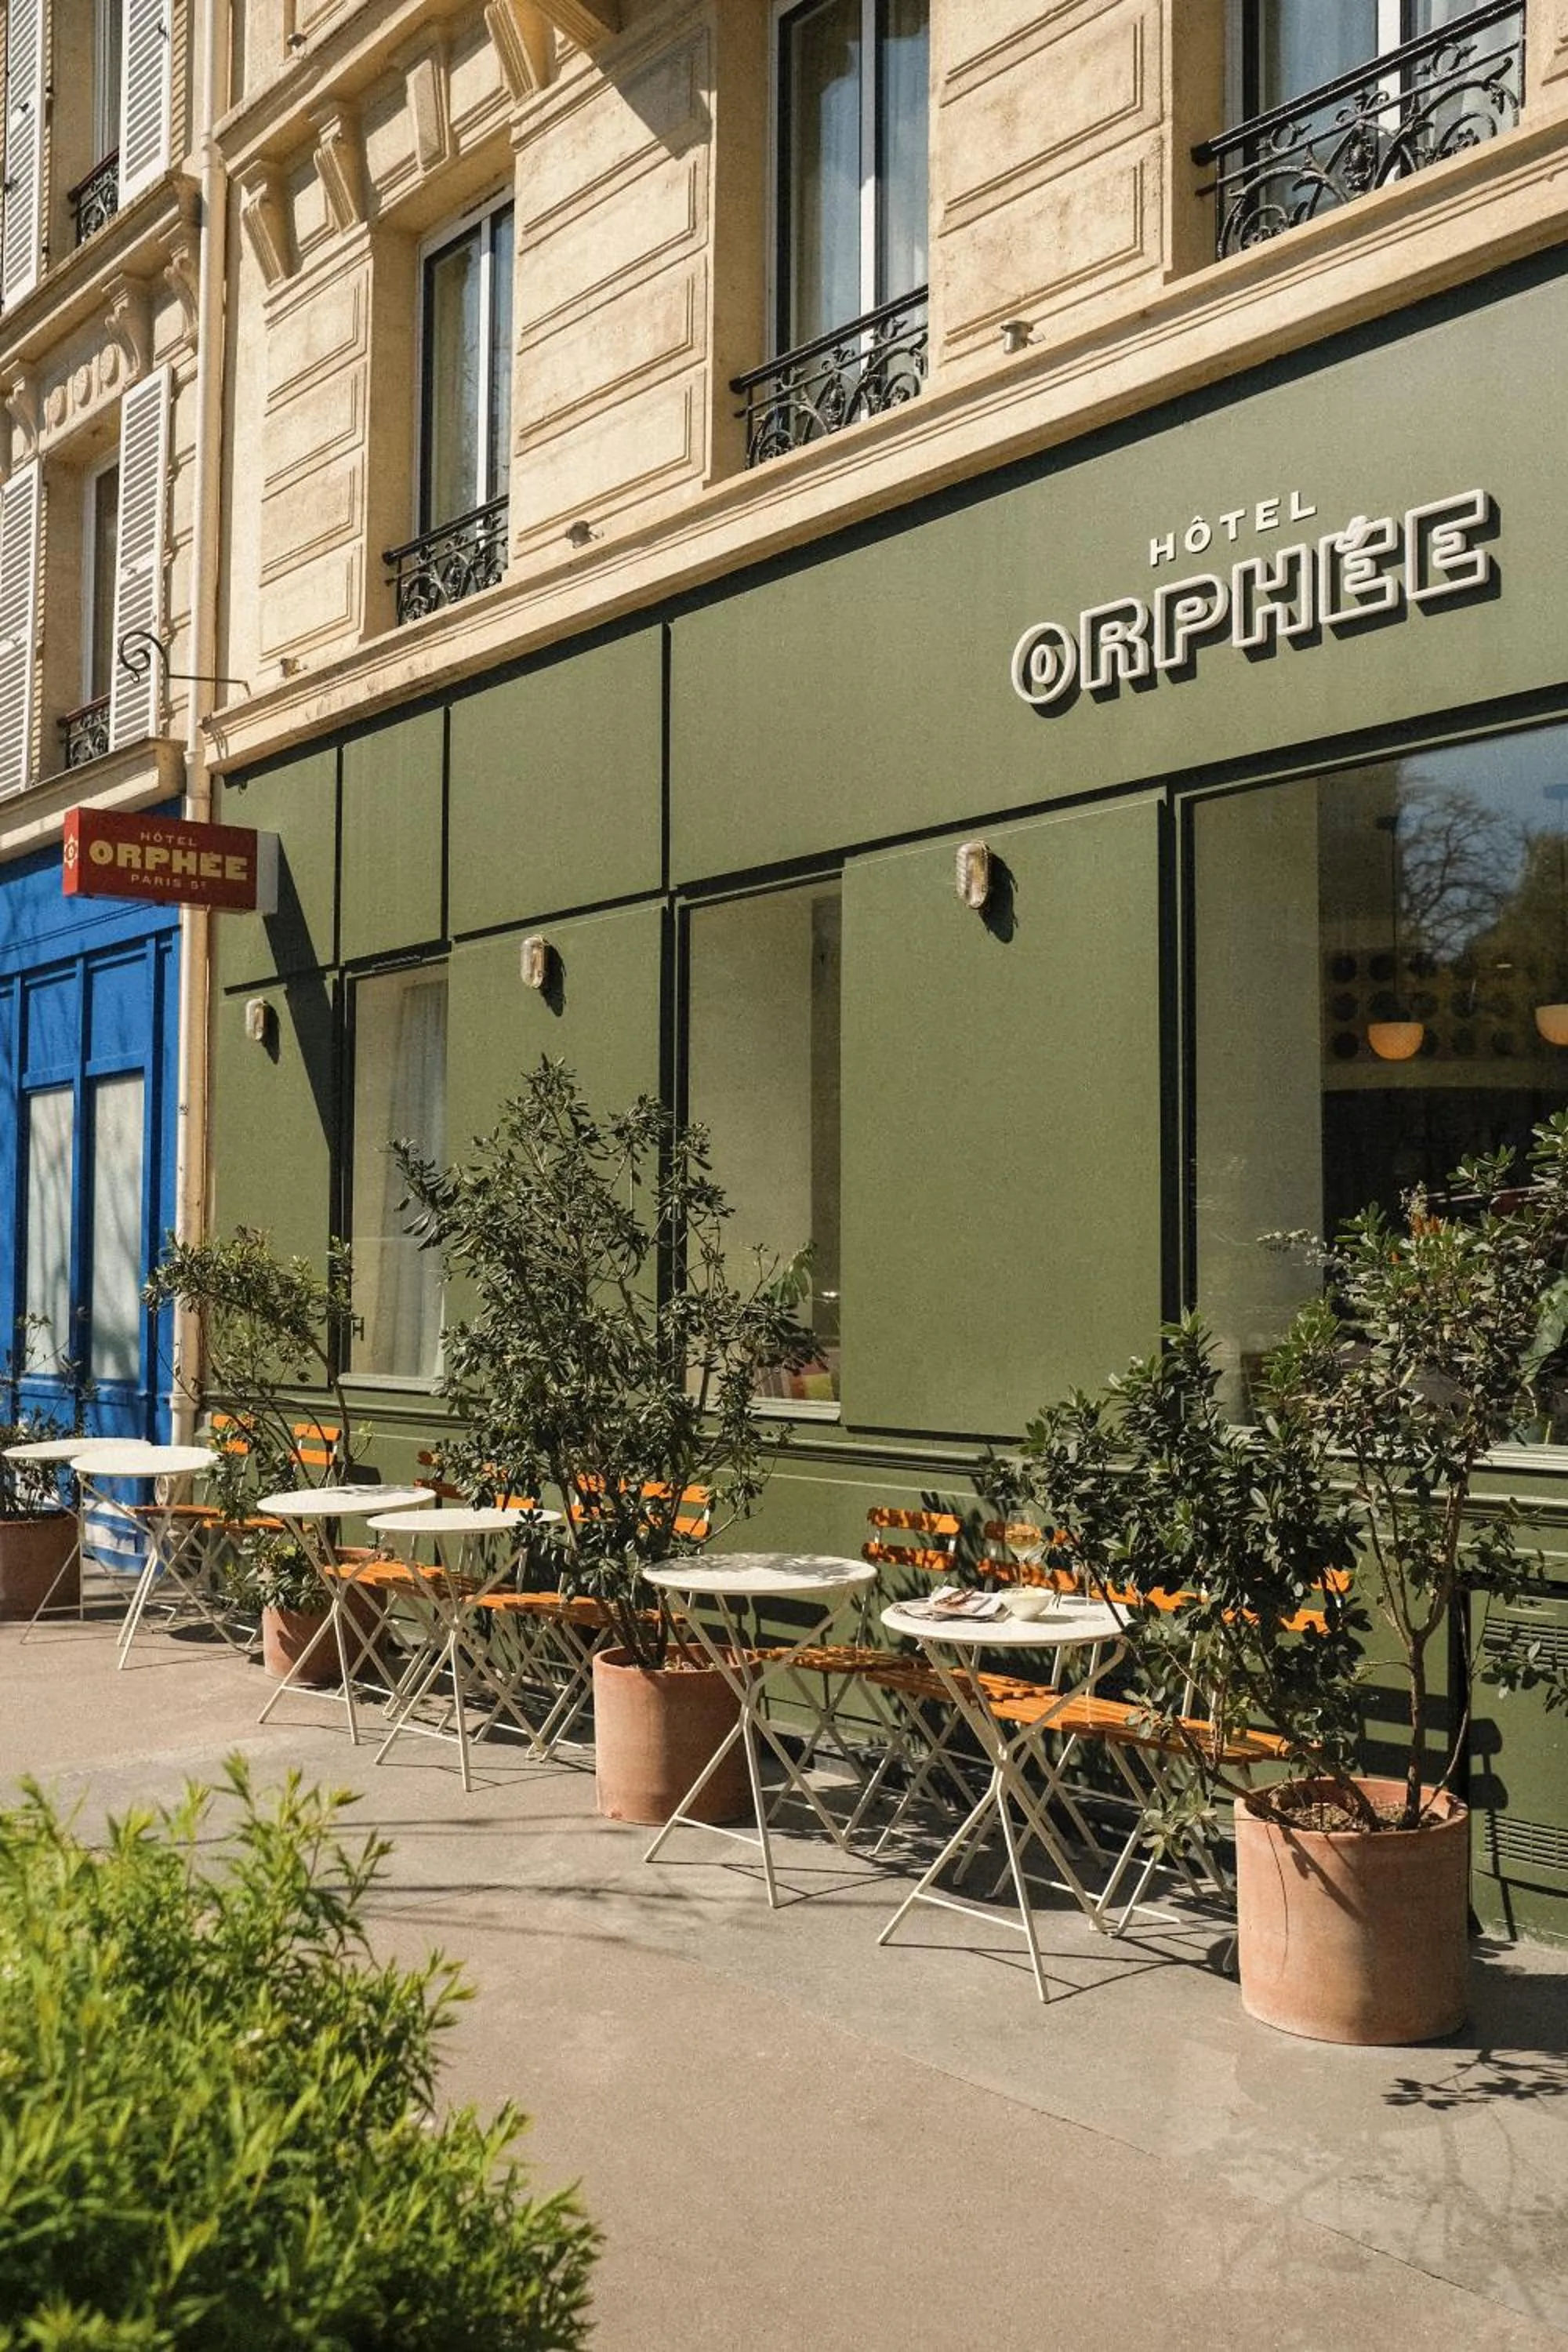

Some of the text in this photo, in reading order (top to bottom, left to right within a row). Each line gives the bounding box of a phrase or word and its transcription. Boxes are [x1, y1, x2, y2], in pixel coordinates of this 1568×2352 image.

[1150, 490, 1317, 567] HÔTEL
[1011, 488, 1491, 705] ORPHÉE
[140, 831, 197, 847] HÔTEL
[89, 840, 248, 881] ORPHÉE
[130, 873, 182, 888] PARIS
